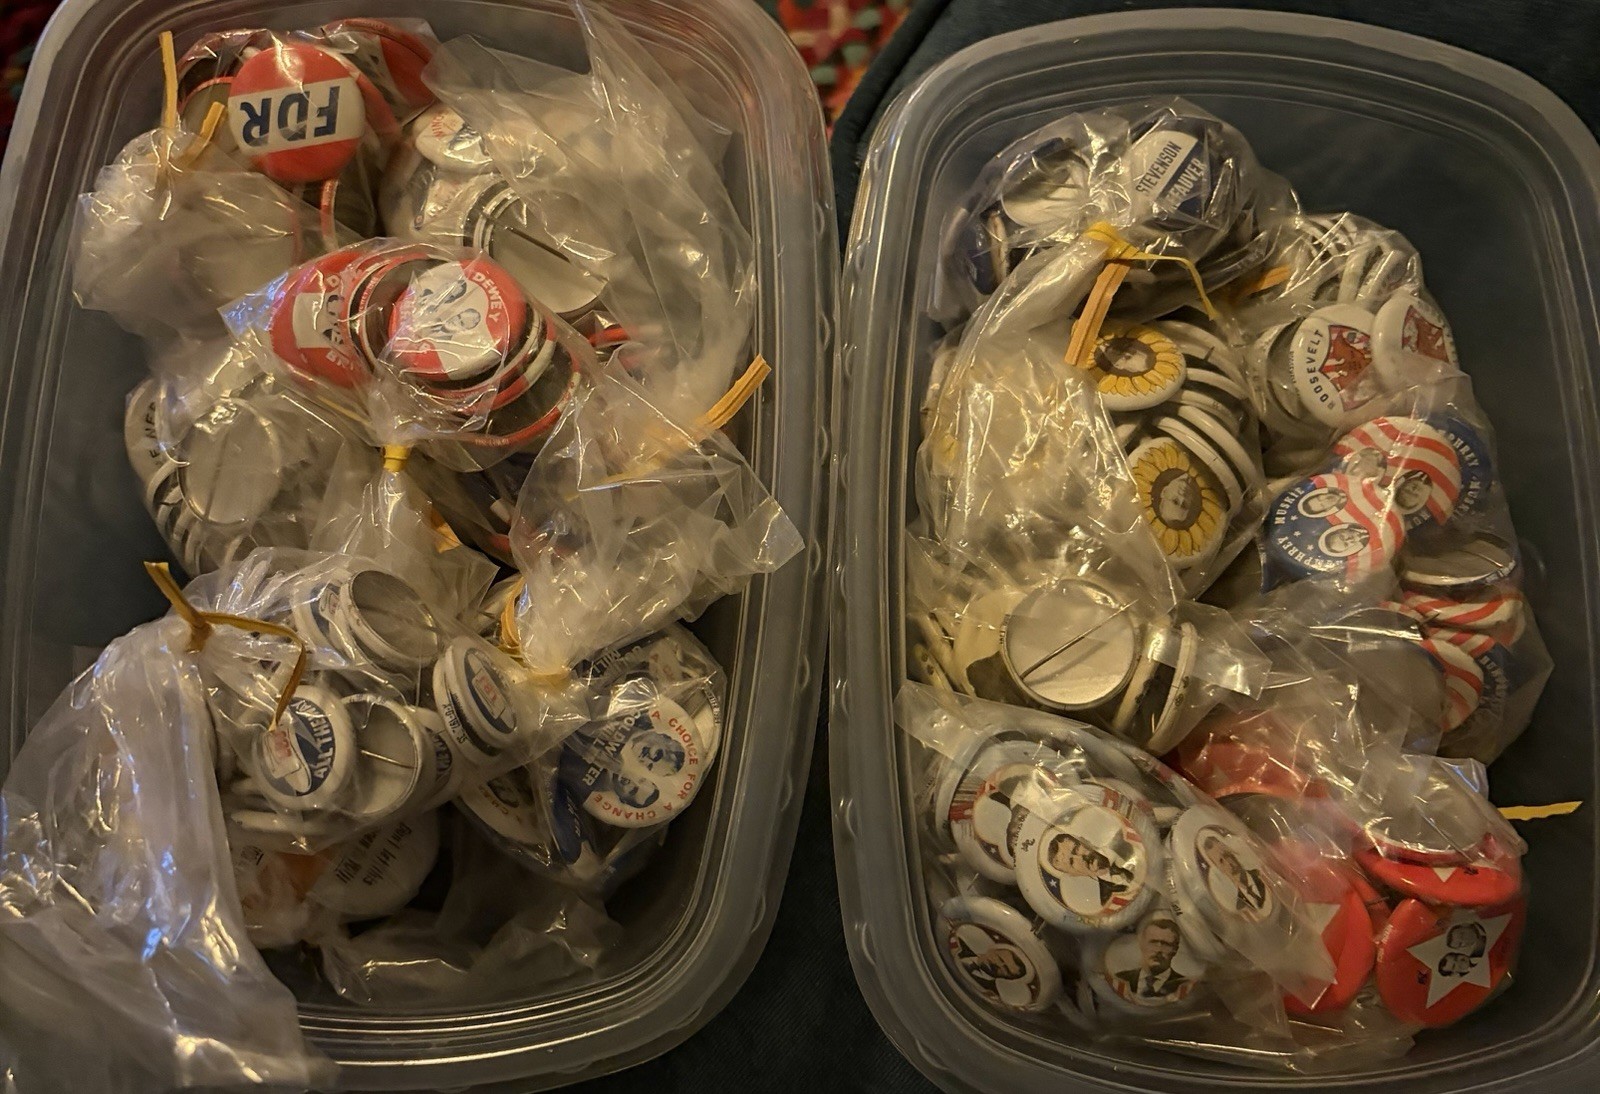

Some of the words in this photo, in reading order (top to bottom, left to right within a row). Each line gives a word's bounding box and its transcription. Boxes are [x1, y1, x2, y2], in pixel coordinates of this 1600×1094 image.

[240, 86, 340, 147] FDR
[1135, 141, 1183, 196] STEVENSON
[472, 271, 503, 323] DEWEY
[1305, 328, 1336, 410] ROOSEVELT
[1274, 487, 1306, 525] MUSKIE
[310, 713, 333, 751] THE
[652, 710, 662, 720] A
[668, 717, 699, 766] CHOICE
[311, 747, 335, 779] ALL
[677, 773, 697, 799] FOR
[594, 795, 657, 821] CHANGE
[663, 802, 673, 812] A
